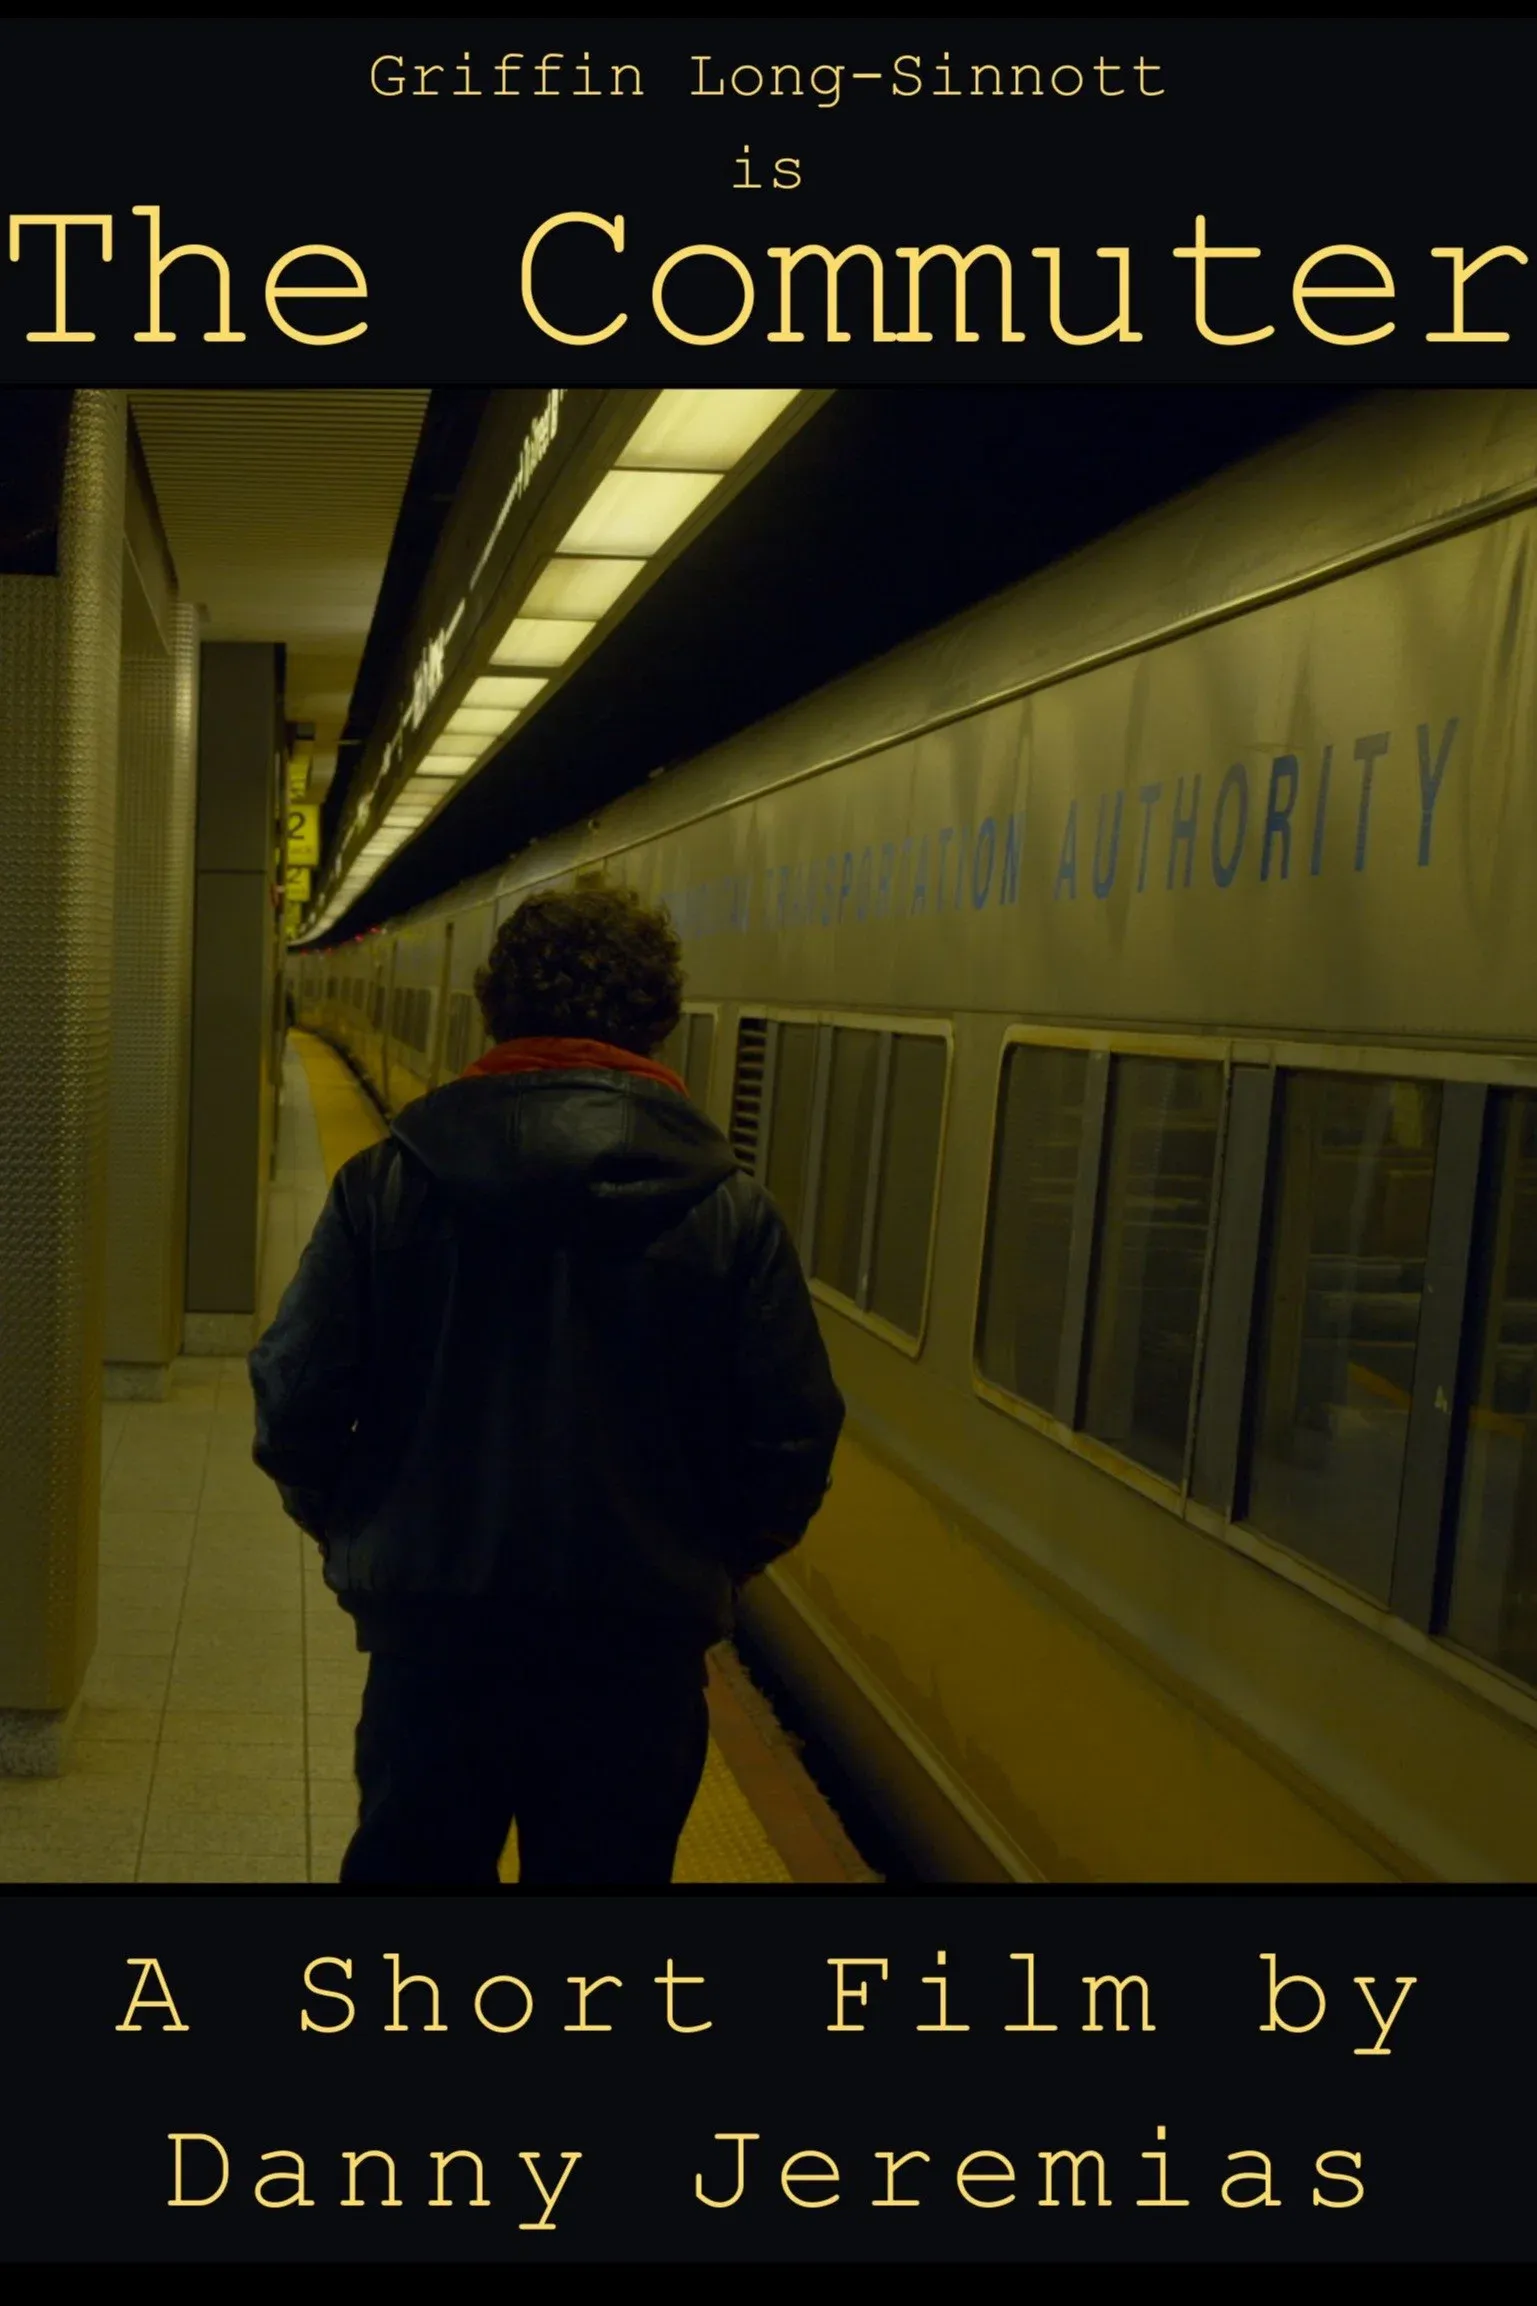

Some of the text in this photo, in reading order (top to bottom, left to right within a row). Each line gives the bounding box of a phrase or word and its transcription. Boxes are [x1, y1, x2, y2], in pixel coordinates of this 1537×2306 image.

[287, 811, 305, 840] 2
[765, 813, 1025, 928] TRANSPORTATION
[1053, 716, 1459, 901] AUTHORITY
